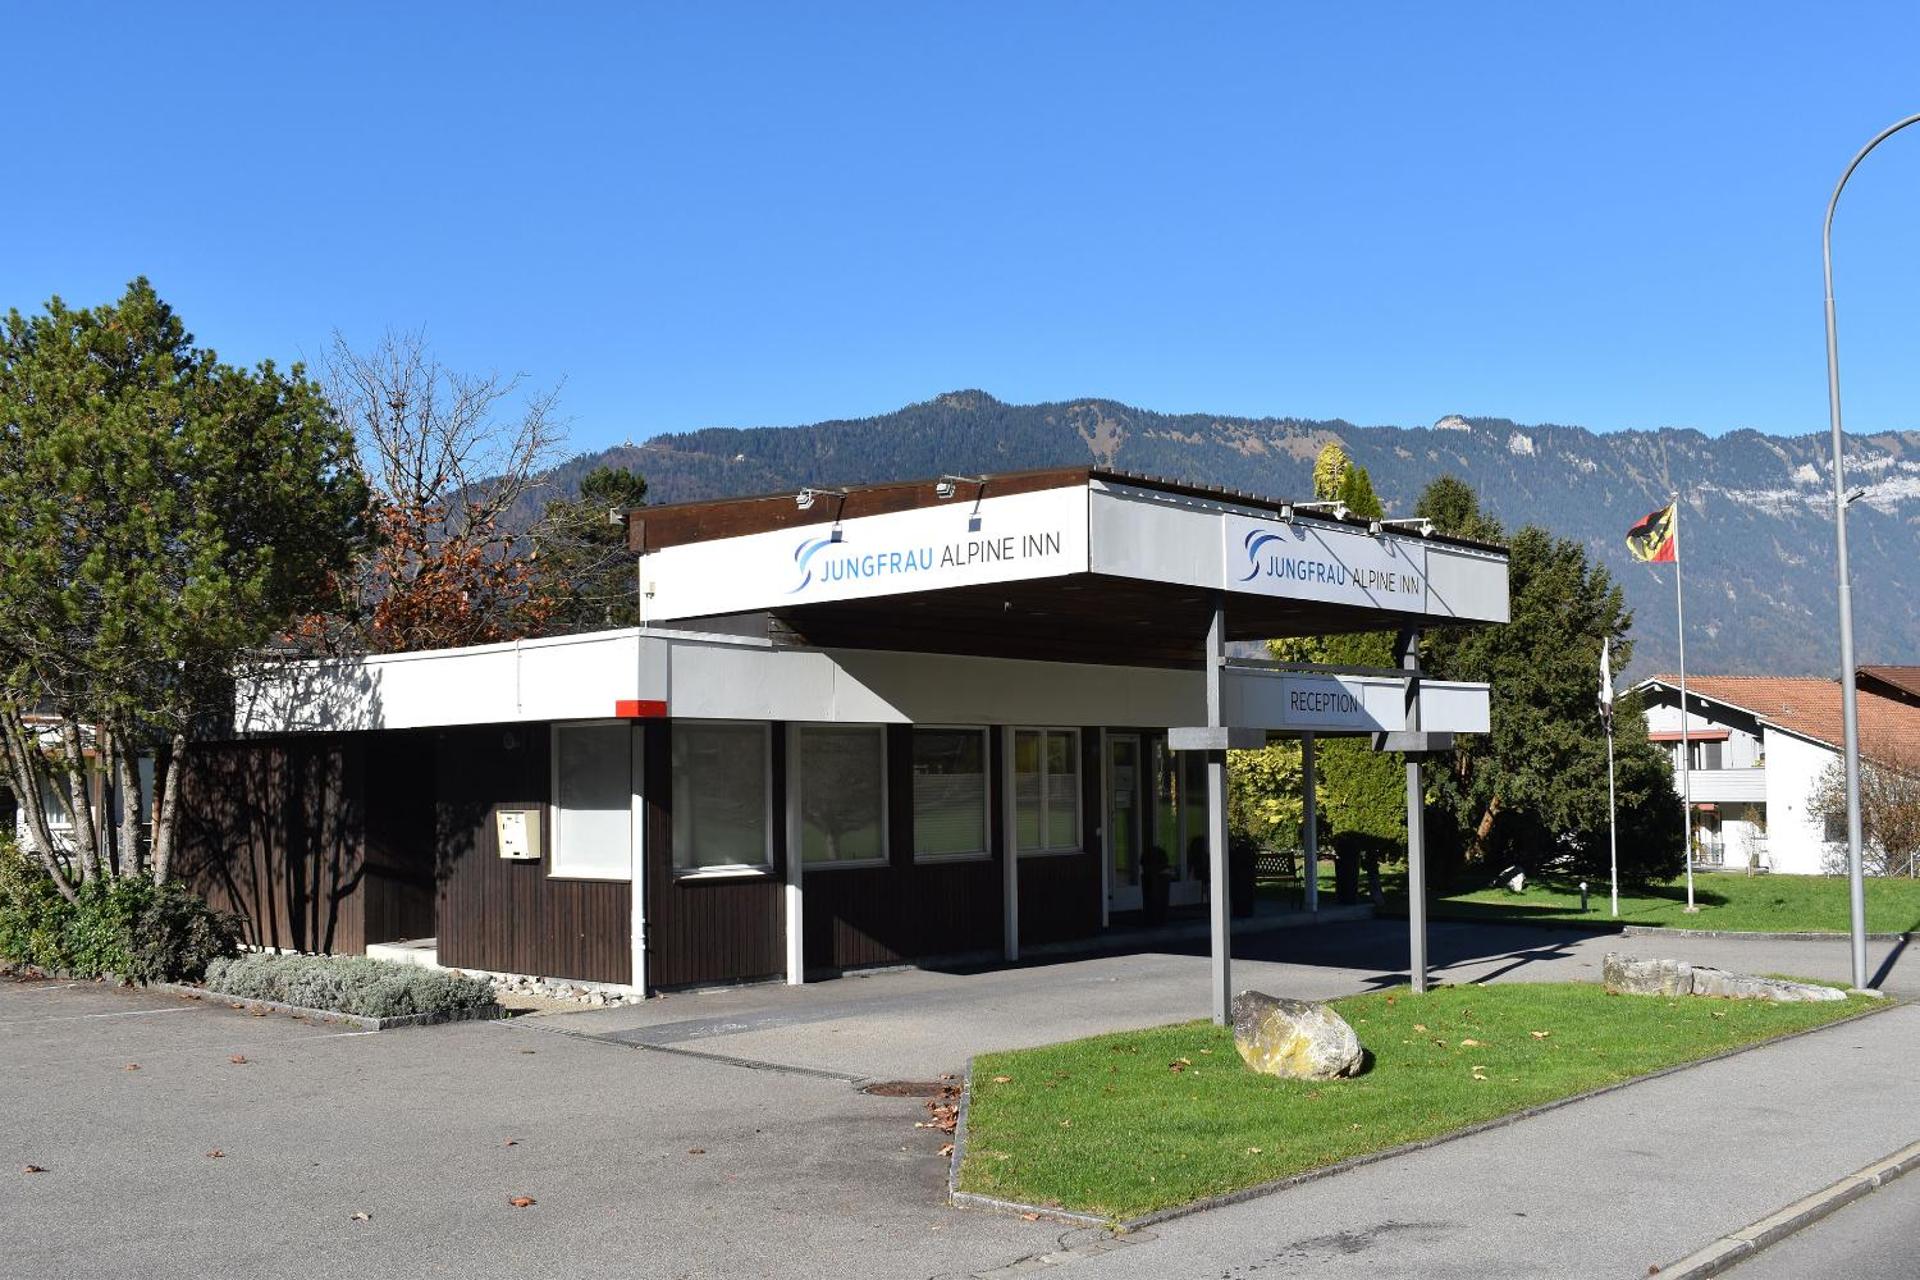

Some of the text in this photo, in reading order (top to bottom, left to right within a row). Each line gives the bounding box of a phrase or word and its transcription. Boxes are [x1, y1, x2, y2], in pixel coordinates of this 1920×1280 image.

[820, 531, 1061, 583] JUNGFRAU ALPINE INN
[1266, 556, 1419, 595] JUNGFRAU ALPINE INN
[1290, 691, 1358, 713] RECEPTION
